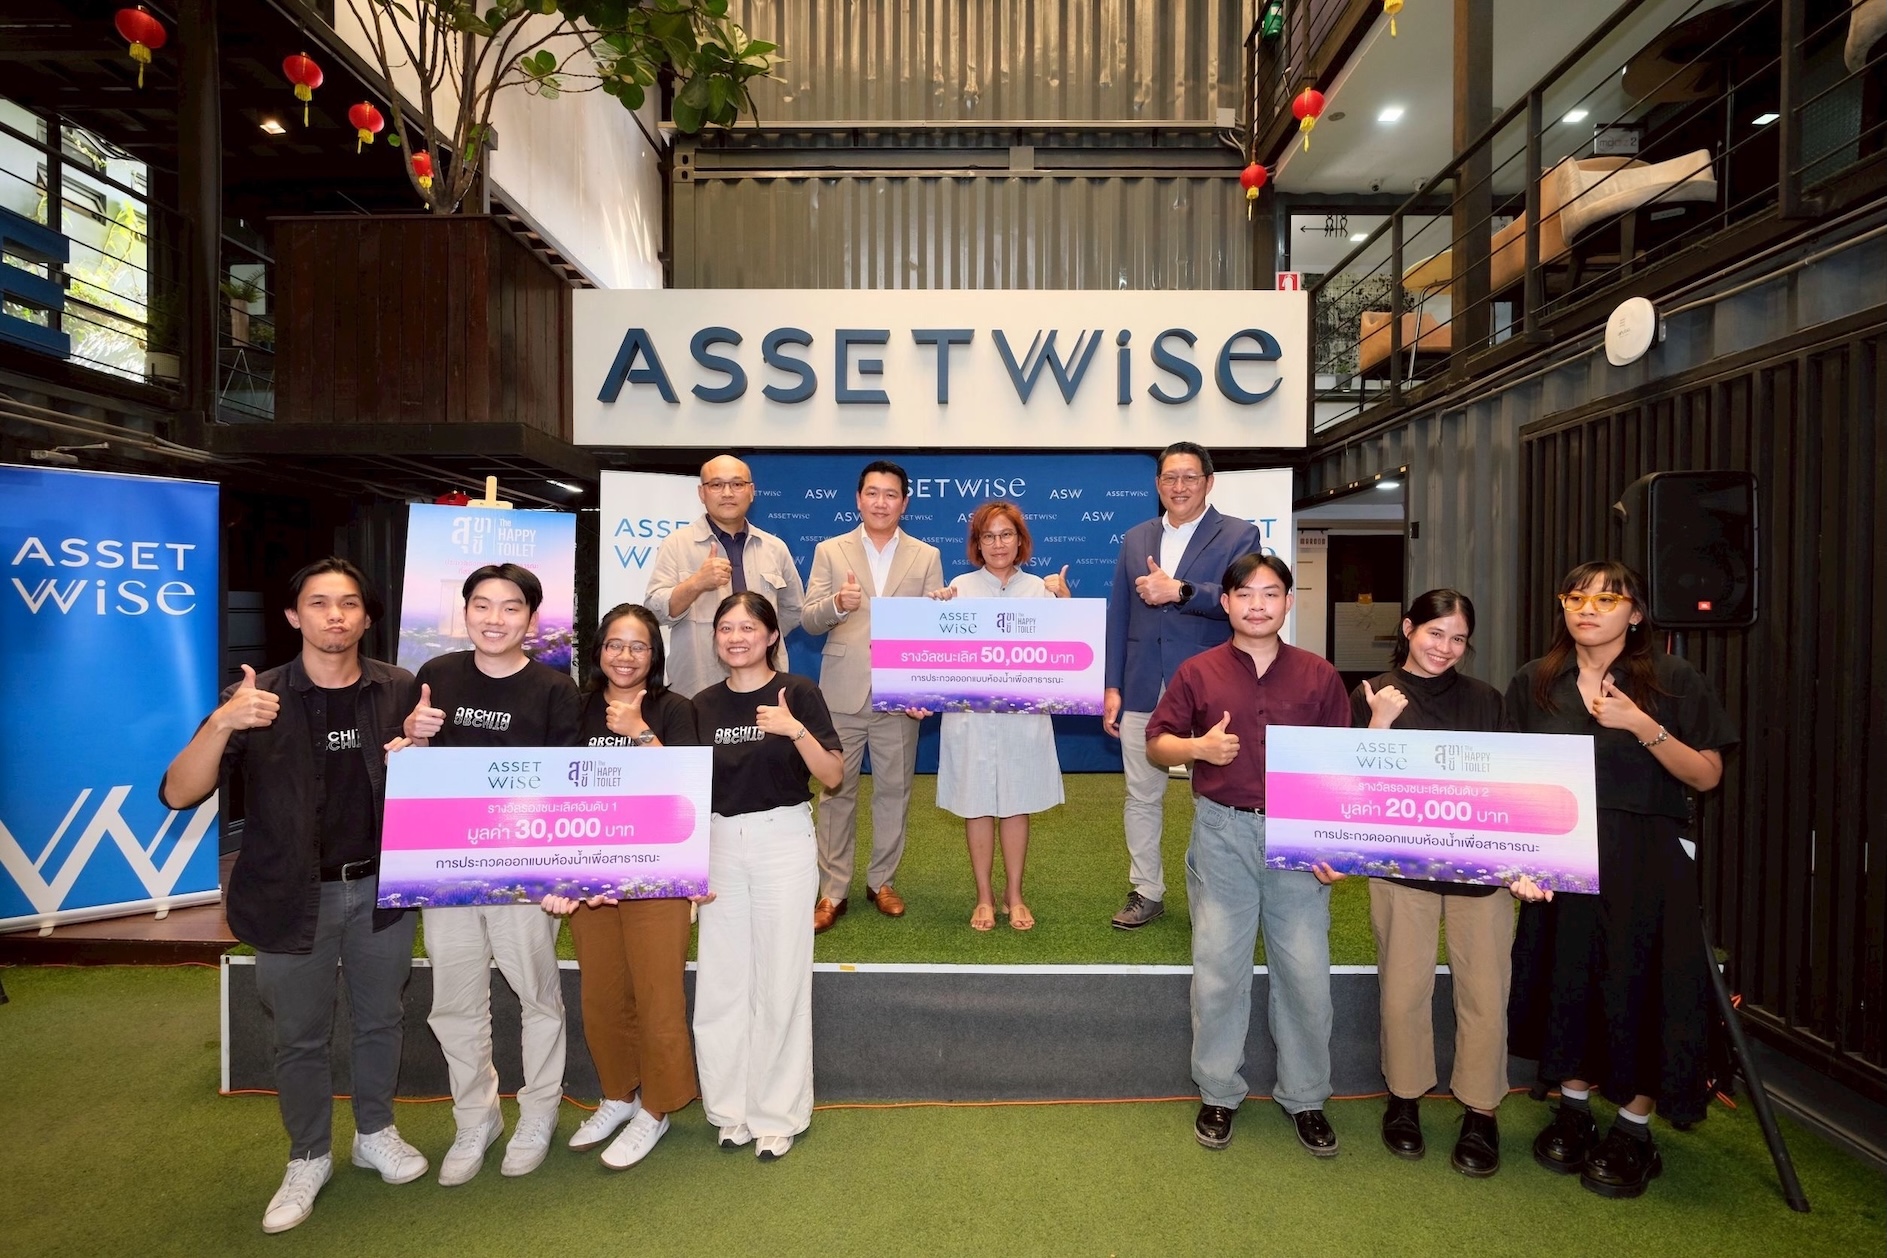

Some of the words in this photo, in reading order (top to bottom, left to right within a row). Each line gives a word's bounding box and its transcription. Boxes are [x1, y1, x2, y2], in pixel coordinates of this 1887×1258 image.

[804, 488, 838, 499] ASW
[1049, 488, 1083, 500] ASW
[499, 518, 512, 527] The
[1081, 511, 1115, 522] ASW
[497, 529, 537, 543] HAPPY
[11, 537, 196, 570] ASSET
[496, 543, 537, 557] TOILET
[939, 612, 978, 621] ASSET
[1018, 626, 1036, 634] TOILET
[901, 650, 978, 663] รางวัลชนะเลิศ
[980, 646, 1048, 666] 50,000
[1050, 653, 1075, 664] บาท
[715, 725, 765, 739] ARCHIT
[1356, 742, 1408, 754] ASSET
[1464, 752, 1491, 762] HAPPY
[488, 761, 542, 773] ASSET
[597, 767, 622, 777] HAPPY
[1464, 762, 1491, 773] TOILET
[597, 777, 621, 787] TOILET
[1481, 787, 1489, 796] 2
[612, 802, 617, 812] 1
[1340, 801, 1381, 819] มูลค่า
[1385, 797, 1472, 823] 20,000
[1476, 811, 1509, 823] บาท
[467, 824, 511, 845] มูลค่า
[515, 817, 601, 843] 30,000
[605, 823, 635, 837] บาท
[1313, 829, 1540, 852] การประกวดออกแบบห้องน้ำเพื่อสาธารณะ
[436, 849, 661, 869] การประกวดออกแบบห้องน้ำเพื่อสาธารณะ
